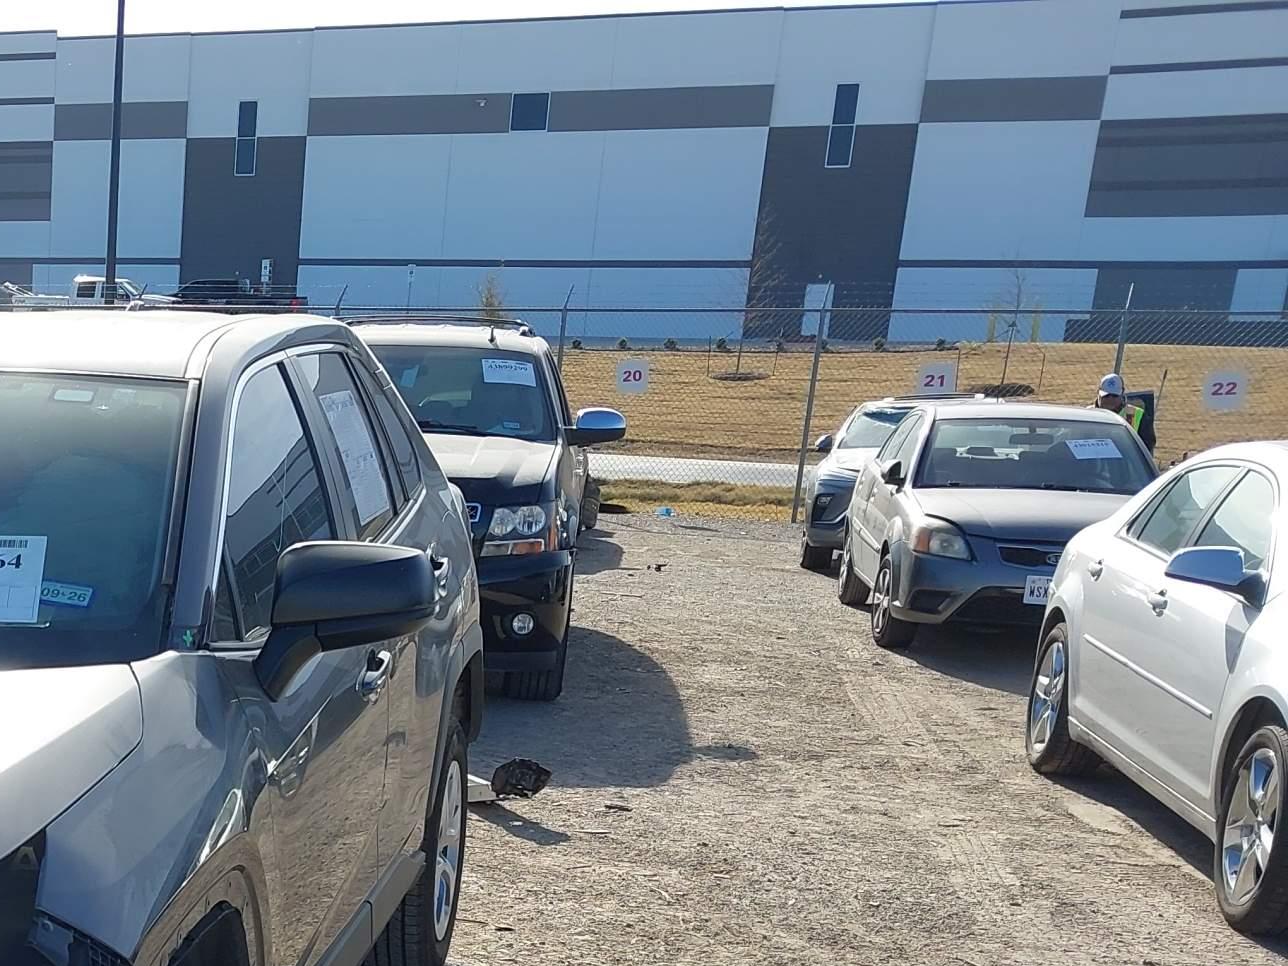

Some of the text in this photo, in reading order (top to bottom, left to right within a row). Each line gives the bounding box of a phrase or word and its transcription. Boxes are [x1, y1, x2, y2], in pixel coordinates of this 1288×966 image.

[623, 370, 642, 382] 20
[923, 374, 945, 388] 21
[1211, 382, 1238, 396] 22
